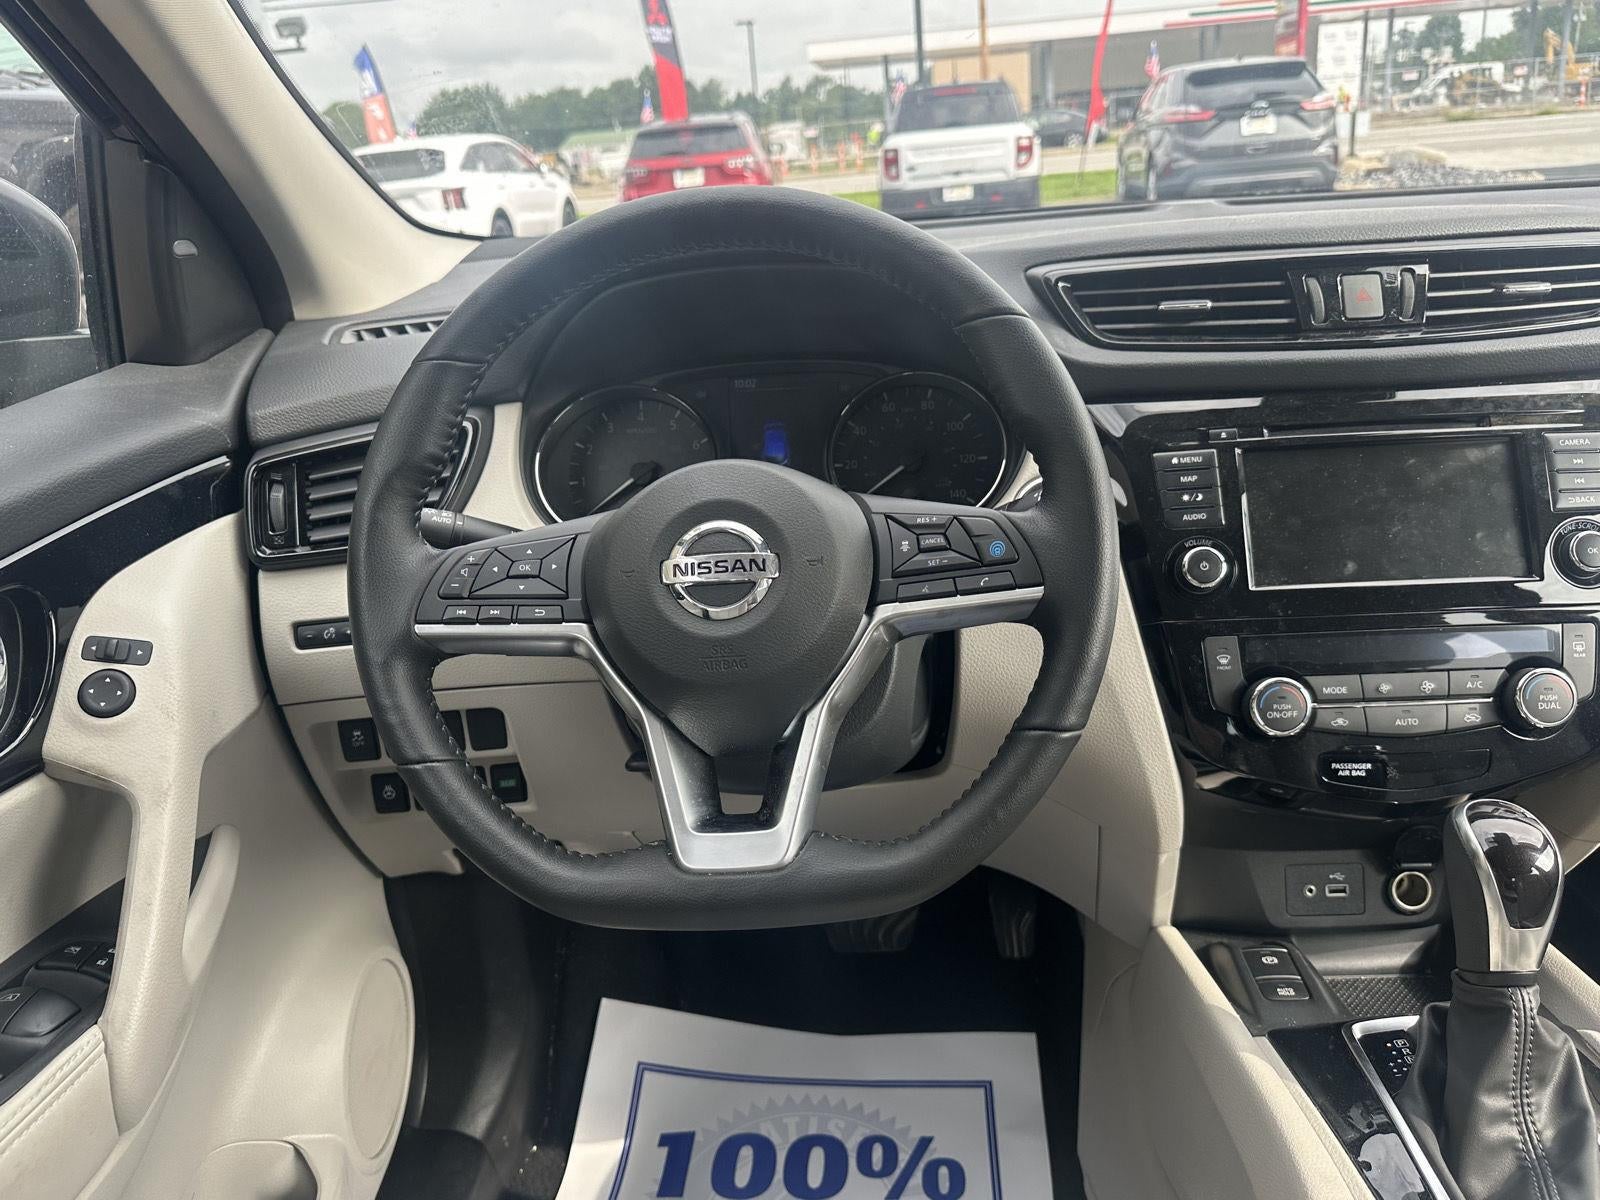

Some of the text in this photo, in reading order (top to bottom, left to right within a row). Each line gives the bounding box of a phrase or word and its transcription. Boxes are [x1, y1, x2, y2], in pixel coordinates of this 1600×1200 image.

[882, 403, 896, 413] 60
[921, 401, 935, 410] 80
[607, 422, 614, 433] 3
[670, 421, 677, 430] 5
[946, 421, 964, 432] 100
[853, 426, 867, 436] 40
[692, 440, 700, 450] 6
[1559, 438, 1591, 446] CAMERA
[959, 453, 976, 463] 120
[1180, 456, 1202, 464] MENU
[844, 459, 858, 470] 20
[1180, 475, 1198, 483] MAP
[431, 515, 453, 524] AUTO
[1182, 513, 1207, 521] AUDIO
[921, 537, 946, 545] CANCEL
[1183, 539, 1213, 548] VOLUME
[927, 559, 940, 567] SET
[519, 564, 531, 572] OK
[672, 557, 767, 579] NISSAN
[703, 658, 748, 671] AIRBAG
[1466, 680, 1483, 689] A/C
[1322, 686, 1348, 694] MODE
[1538, 702, 1561, 710] DUAL
[1395, 718, 1419, 726] AUTO
[1331, 762, 1372, 770] PASSENGER
[1337, 769, 1366, 777] AIR BAG
[656, 1129, 967, 1200] 100%
